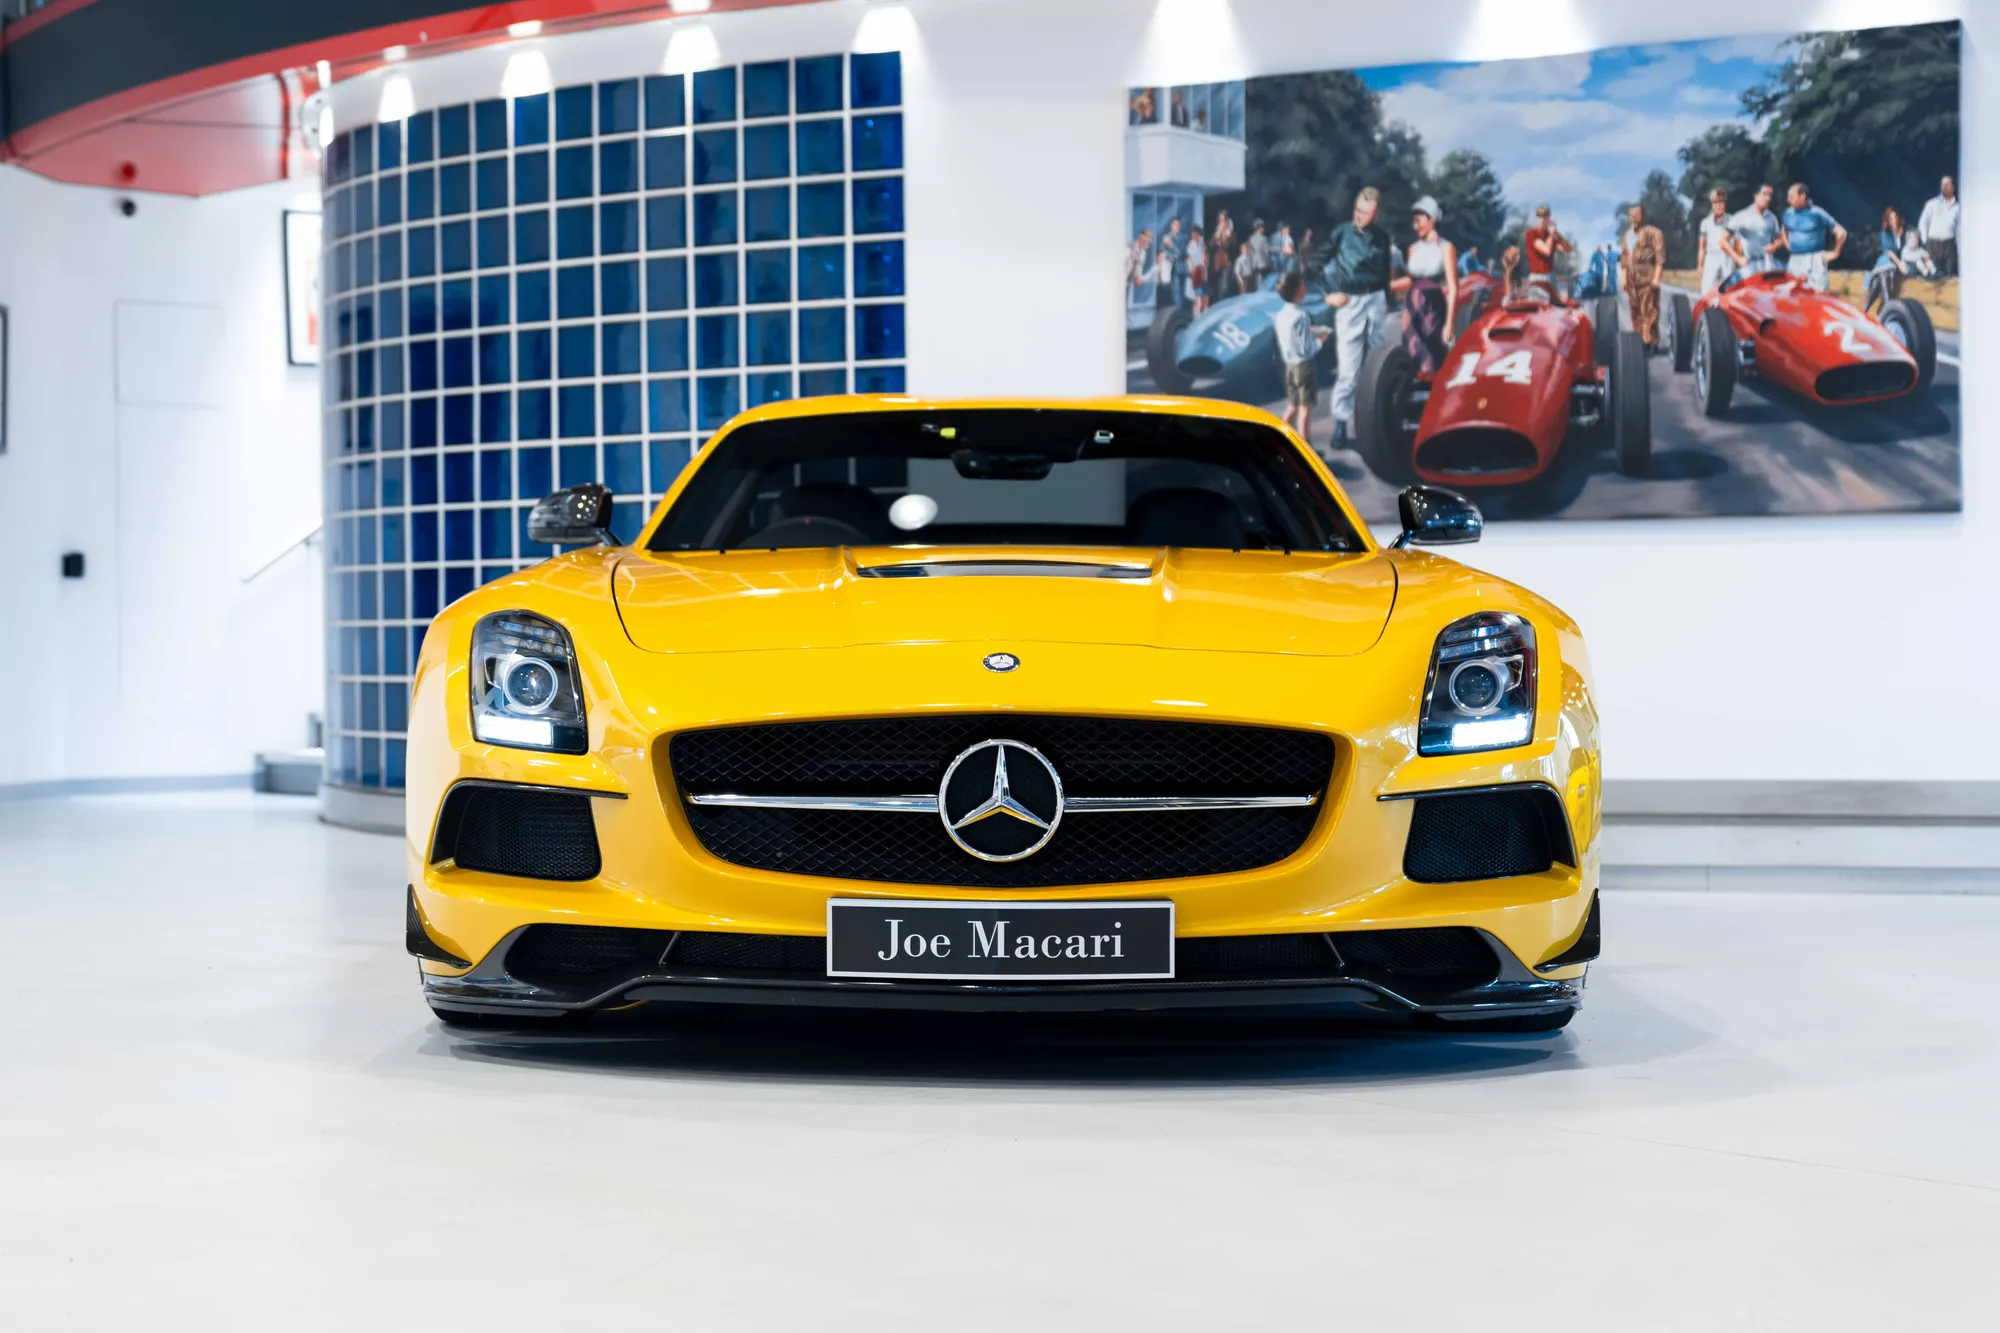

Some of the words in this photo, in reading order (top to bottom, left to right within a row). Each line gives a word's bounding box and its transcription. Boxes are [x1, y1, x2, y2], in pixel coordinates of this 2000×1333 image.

[1212, 321, 1251, 351] 18
[1444, 350, 1532, 390] 14
[877, 919, 951, 961] Joe
[967, 920, 1125, 959] Macari
